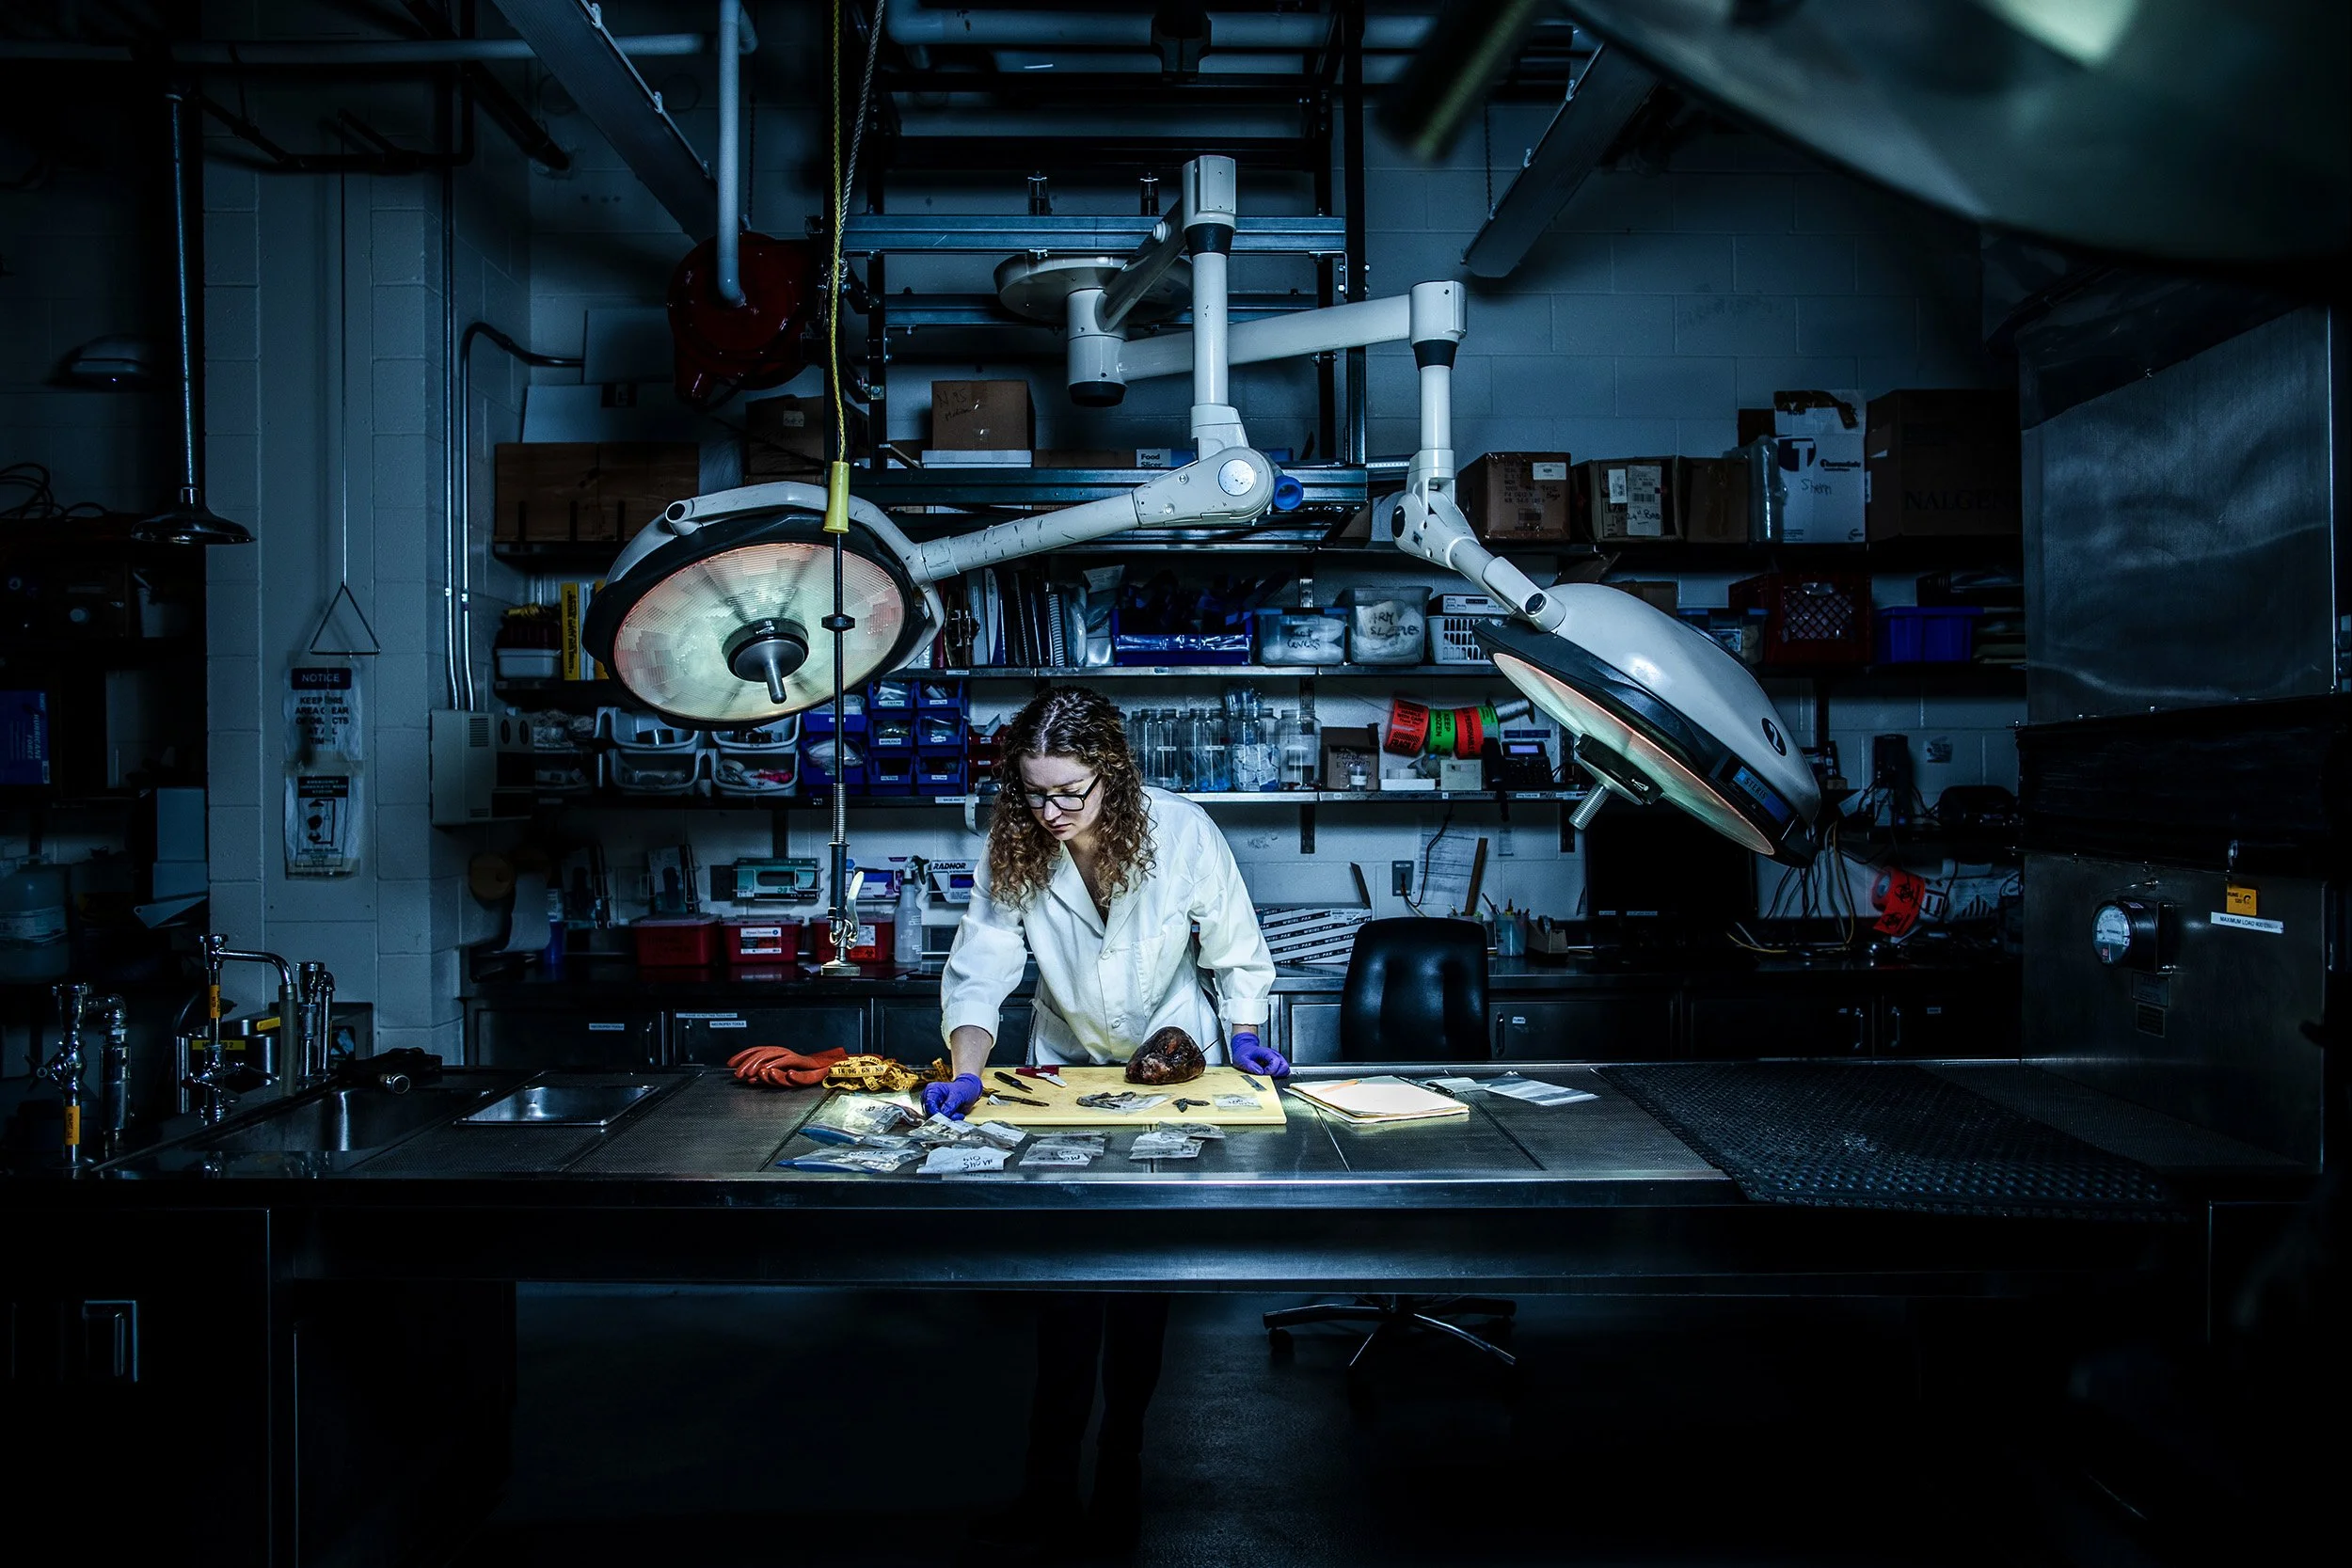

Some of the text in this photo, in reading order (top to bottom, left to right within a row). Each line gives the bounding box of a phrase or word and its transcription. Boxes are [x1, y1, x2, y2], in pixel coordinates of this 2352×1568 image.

[301, 673, 341, 683] NOTICE
[321, 706, 350, 715] CEAR
[1769, 722, 1782, 752] 2
[1744, 776, 1769, 800] STERIS
